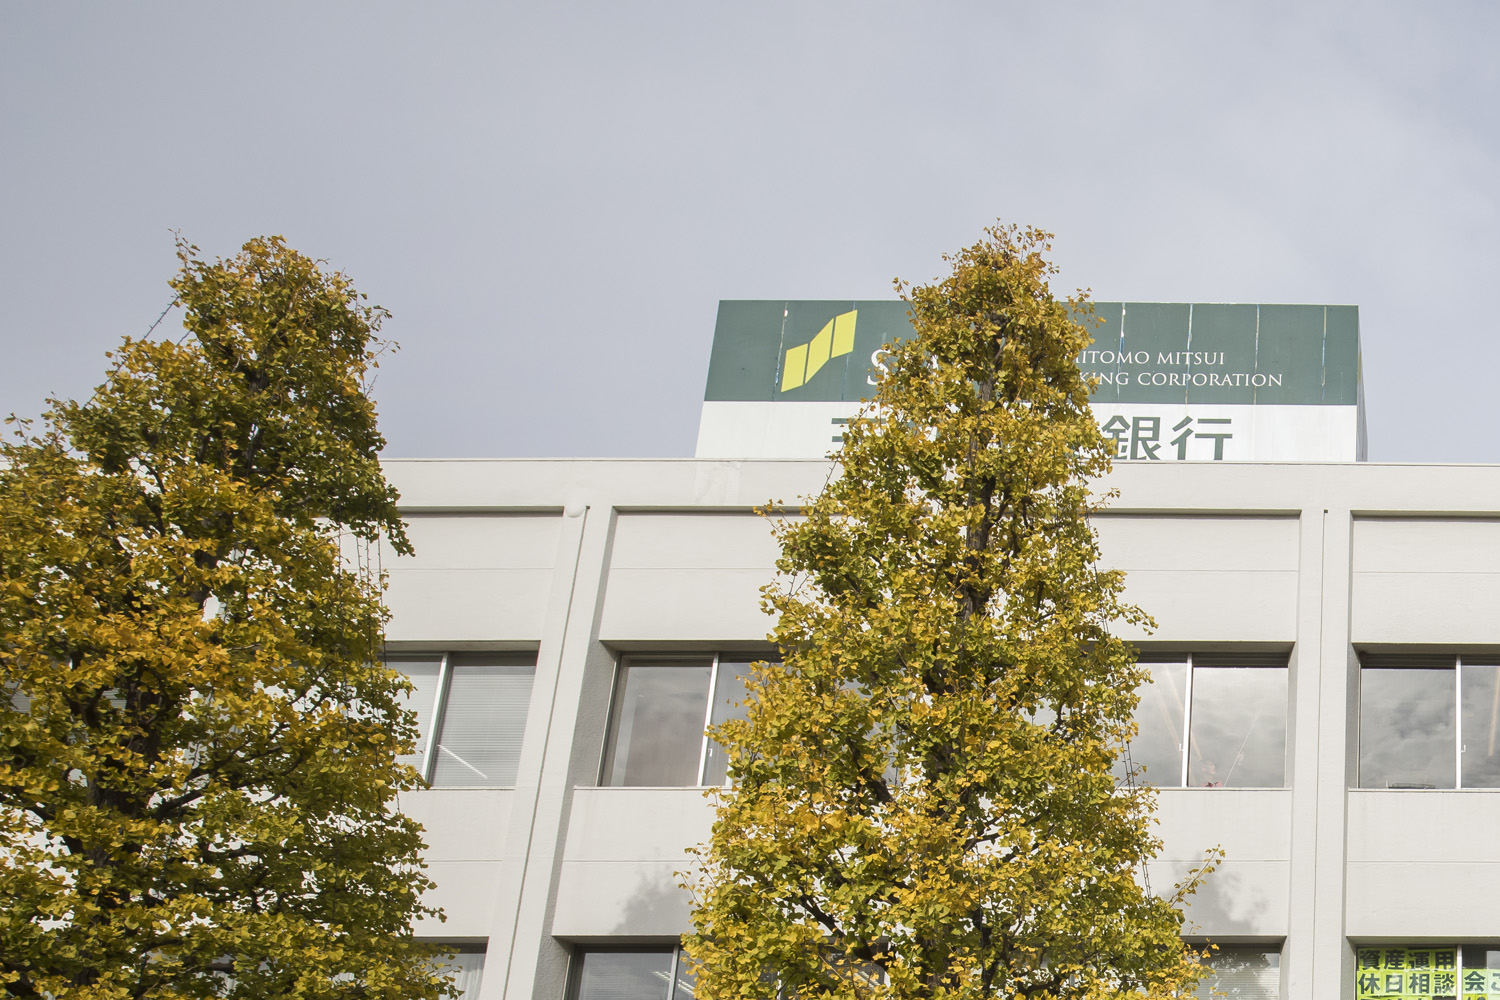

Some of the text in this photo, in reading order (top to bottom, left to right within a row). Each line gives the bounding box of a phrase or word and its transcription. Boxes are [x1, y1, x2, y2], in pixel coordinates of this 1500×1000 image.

[1075, 350, 1225, 365] ITOMO MITSUI
[1079, 372, 1283, 387] KING CORPORATION
[1359, 949, 1455, 970] 資産運用
[1358, 972, 1455, 995] 休日相談
